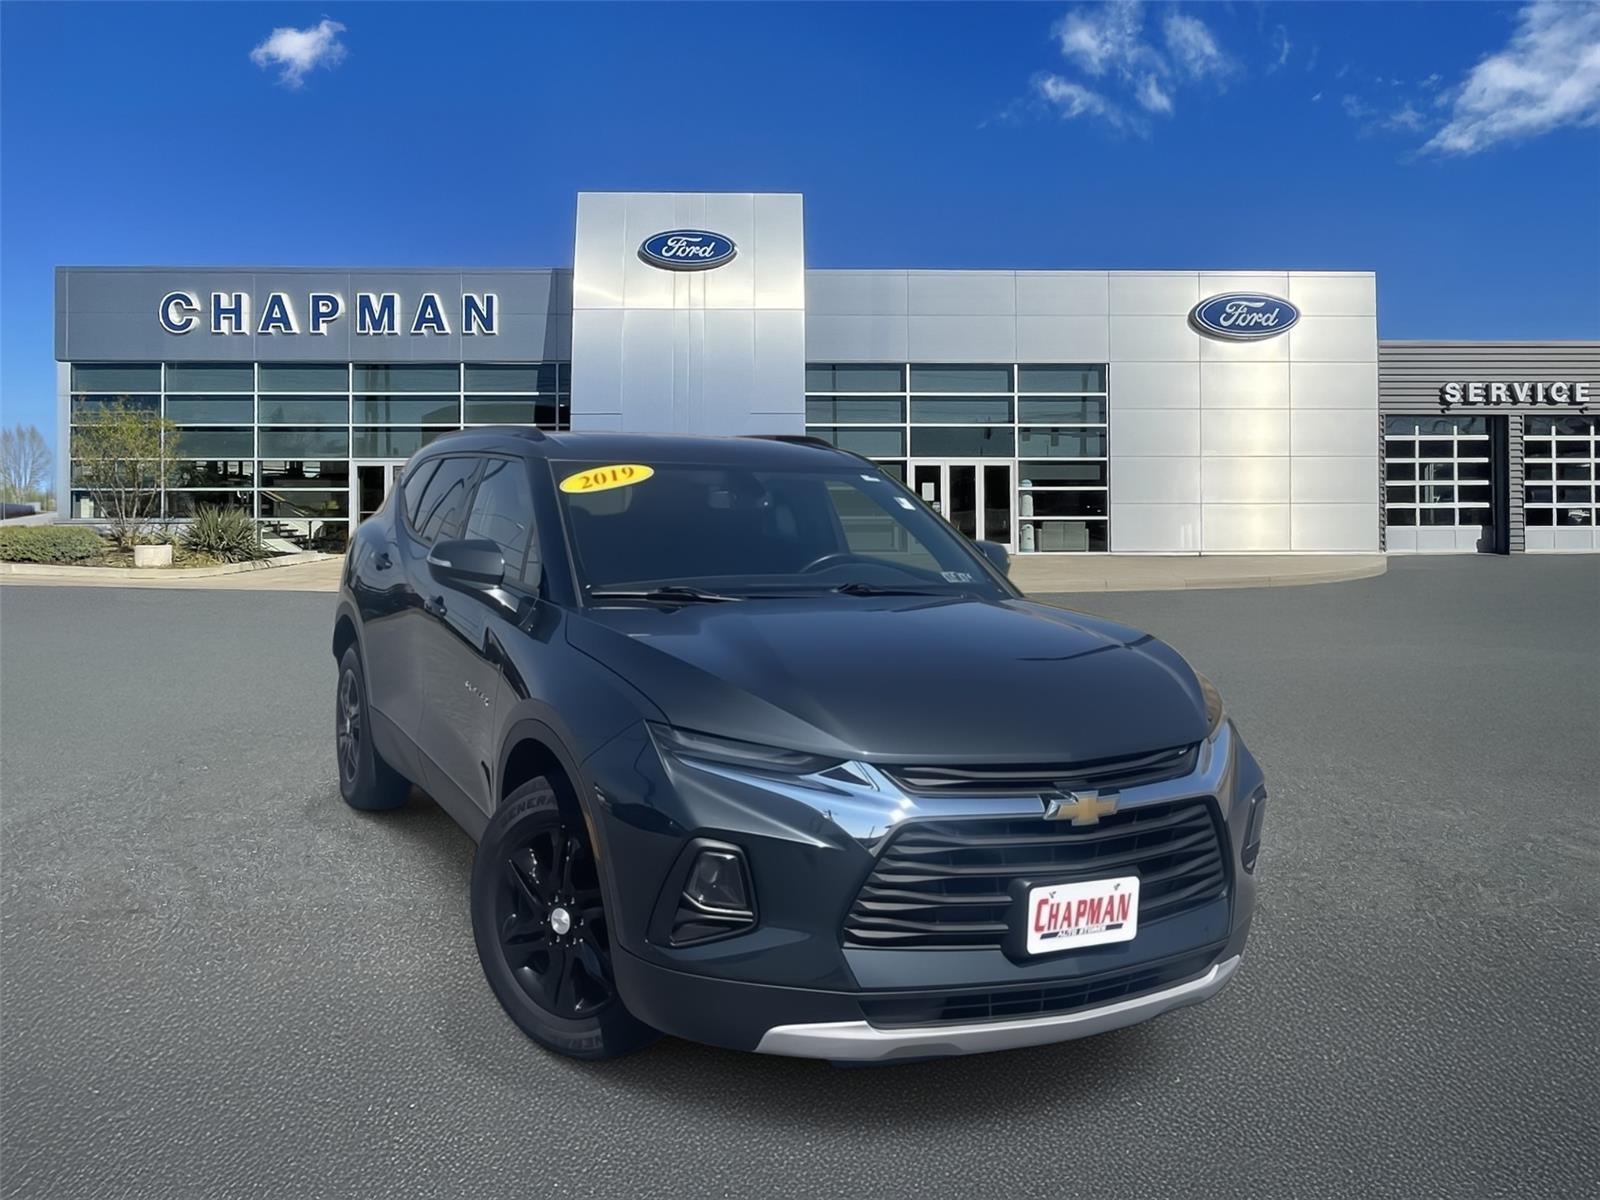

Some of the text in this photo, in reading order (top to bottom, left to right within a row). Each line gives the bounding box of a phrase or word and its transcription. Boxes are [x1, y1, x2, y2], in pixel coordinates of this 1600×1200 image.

[661, 236, 716, 257] Ford
[158, 291, 499, 335] CHAPMAN
[1219, 301, 1280, 327] Ford
[1444, 381, 1591, 403] SERVICE
[579, 466, 634, 489] 2019
[1034, 892, 1132, 933] CHAPMAN
